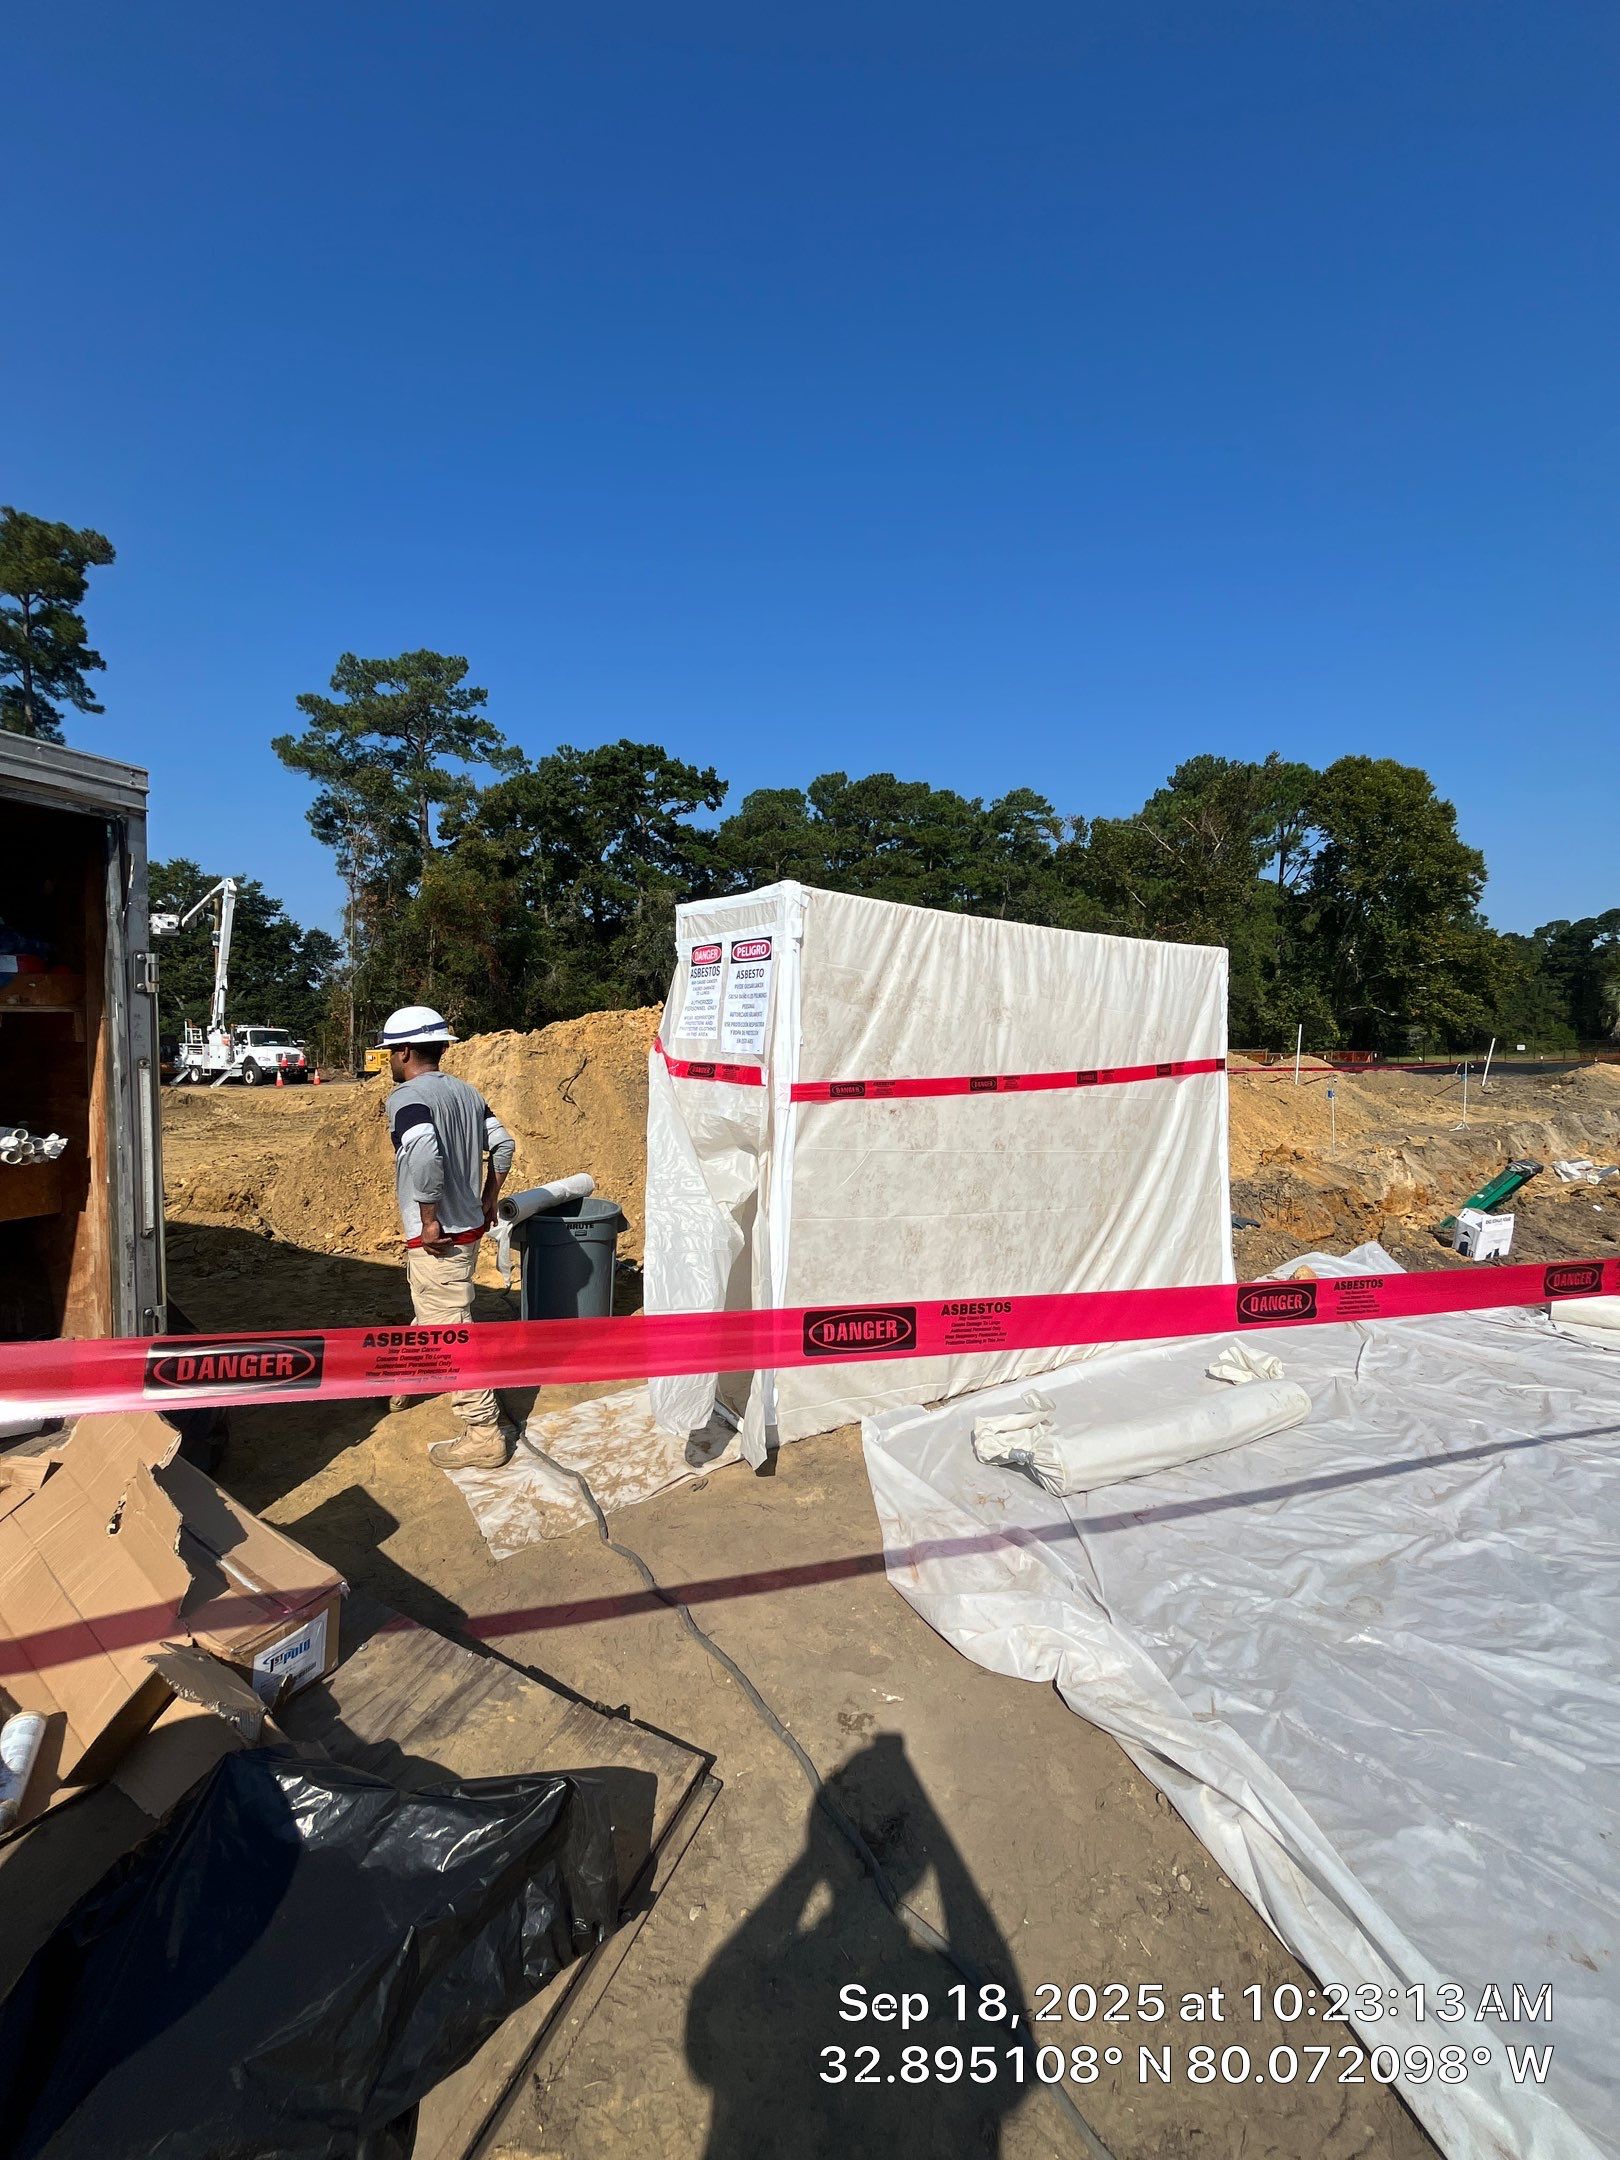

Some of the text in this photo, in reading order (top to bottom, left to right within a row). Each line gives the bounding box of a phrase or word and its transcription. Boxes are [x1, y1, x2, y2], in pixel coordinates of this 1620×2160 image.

[694, 948, 719, 961] DANGER
[736, 944, 766, 957] PELIGRO
[690, 966, 720, 978] ASBESTOS
[736, 968, 764, 979] ASBESTO
[1334, 1279, 1384, 1291] ASBESTOS
[1554, 1272, 1592, 1286] DANGER
[941, 1302, 1012, 1315] ASBESTOS
[1250, 1294, 1302, 1312] DANGER
[823, 1320, 897, 1342] DANGER
[362, 1330, 469, 1348] ASBESTOS
[177, 1353, 294, 1381] DANGER
